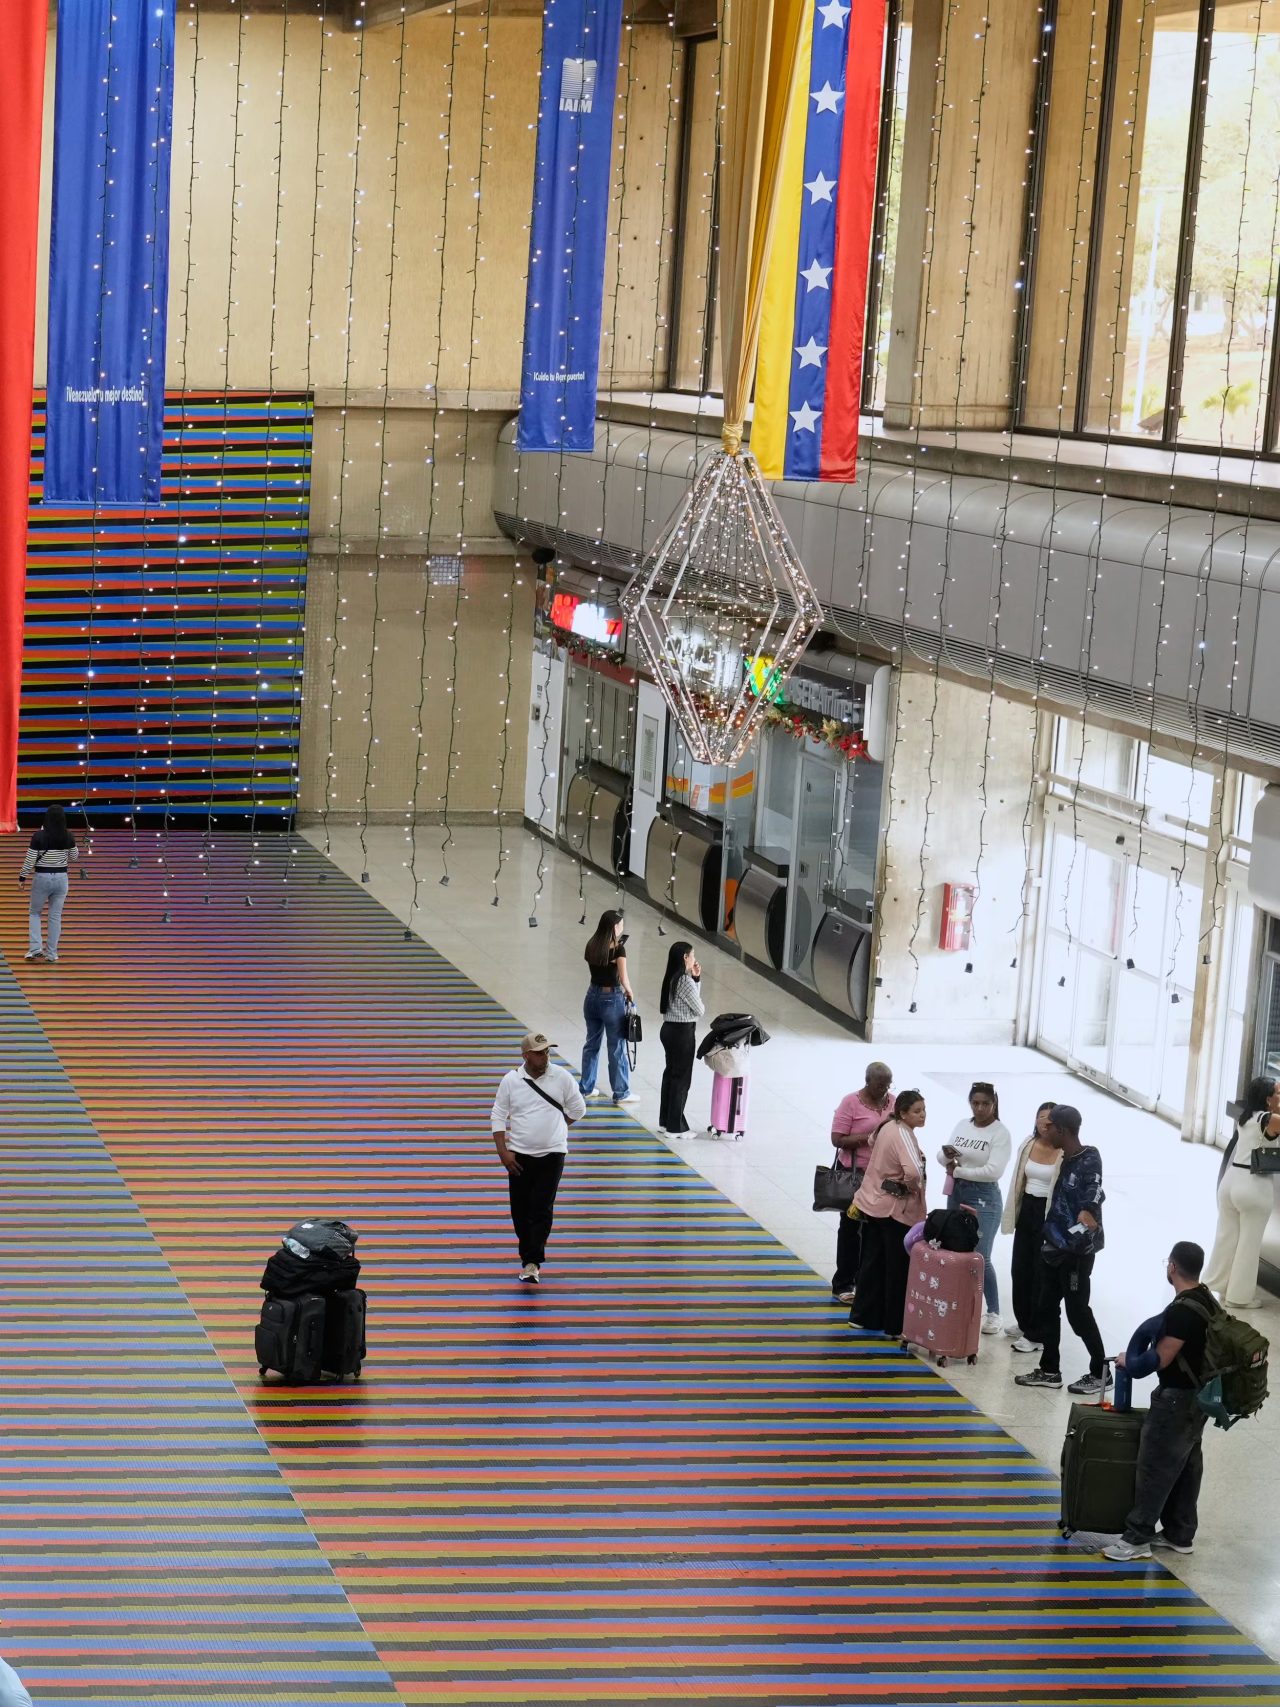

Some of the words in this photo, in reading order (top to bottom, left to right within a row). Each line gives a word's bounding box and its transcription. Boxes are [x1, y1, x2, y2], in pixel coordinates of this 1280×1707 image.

[559, 97, 593, 113] IAIM
[105, 385, 120, 406] mejor
[121, 385, 144, 402] destino!
